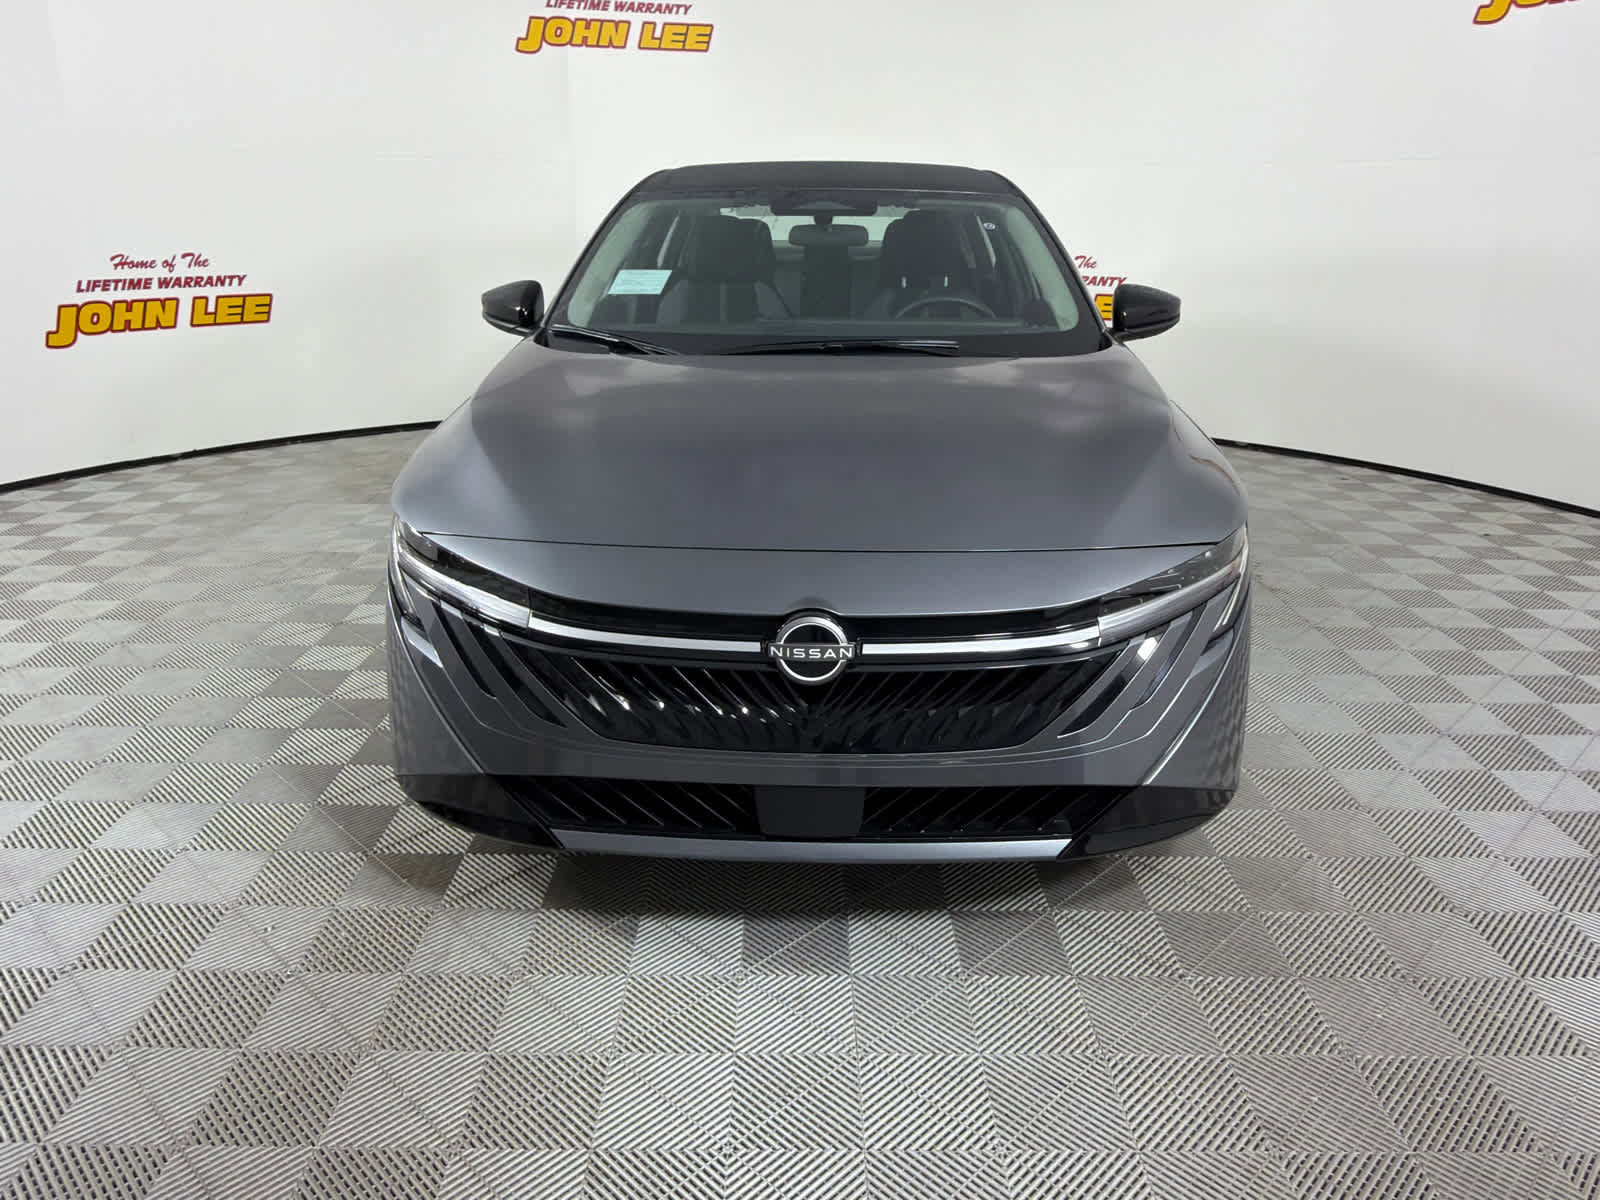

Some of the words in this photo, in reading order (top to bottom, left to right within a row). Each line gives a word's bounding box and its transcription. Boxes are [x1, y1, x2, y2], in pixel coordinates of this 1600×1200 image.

[545, 0, 610, 11] LIFETIME
[614, 1, 692, 15] WARRANTY
[515, 16, 631, 54] JOHN
[638, 21, 714, 52] LEE
[110, 253, 157, 270] Home
[162, 254, 176, 272] of
[181, 252, 209, 269] The
[1074, 255, 1097, 269] The
[76, 278, 153, 293] LIFETIME
[157, 274, 247, 289] WARRANTY
[45, 297, 179, 349] JOHN
[190, 293, 273, 327] LEE
[770, 645, 852, 658] NISSAN
